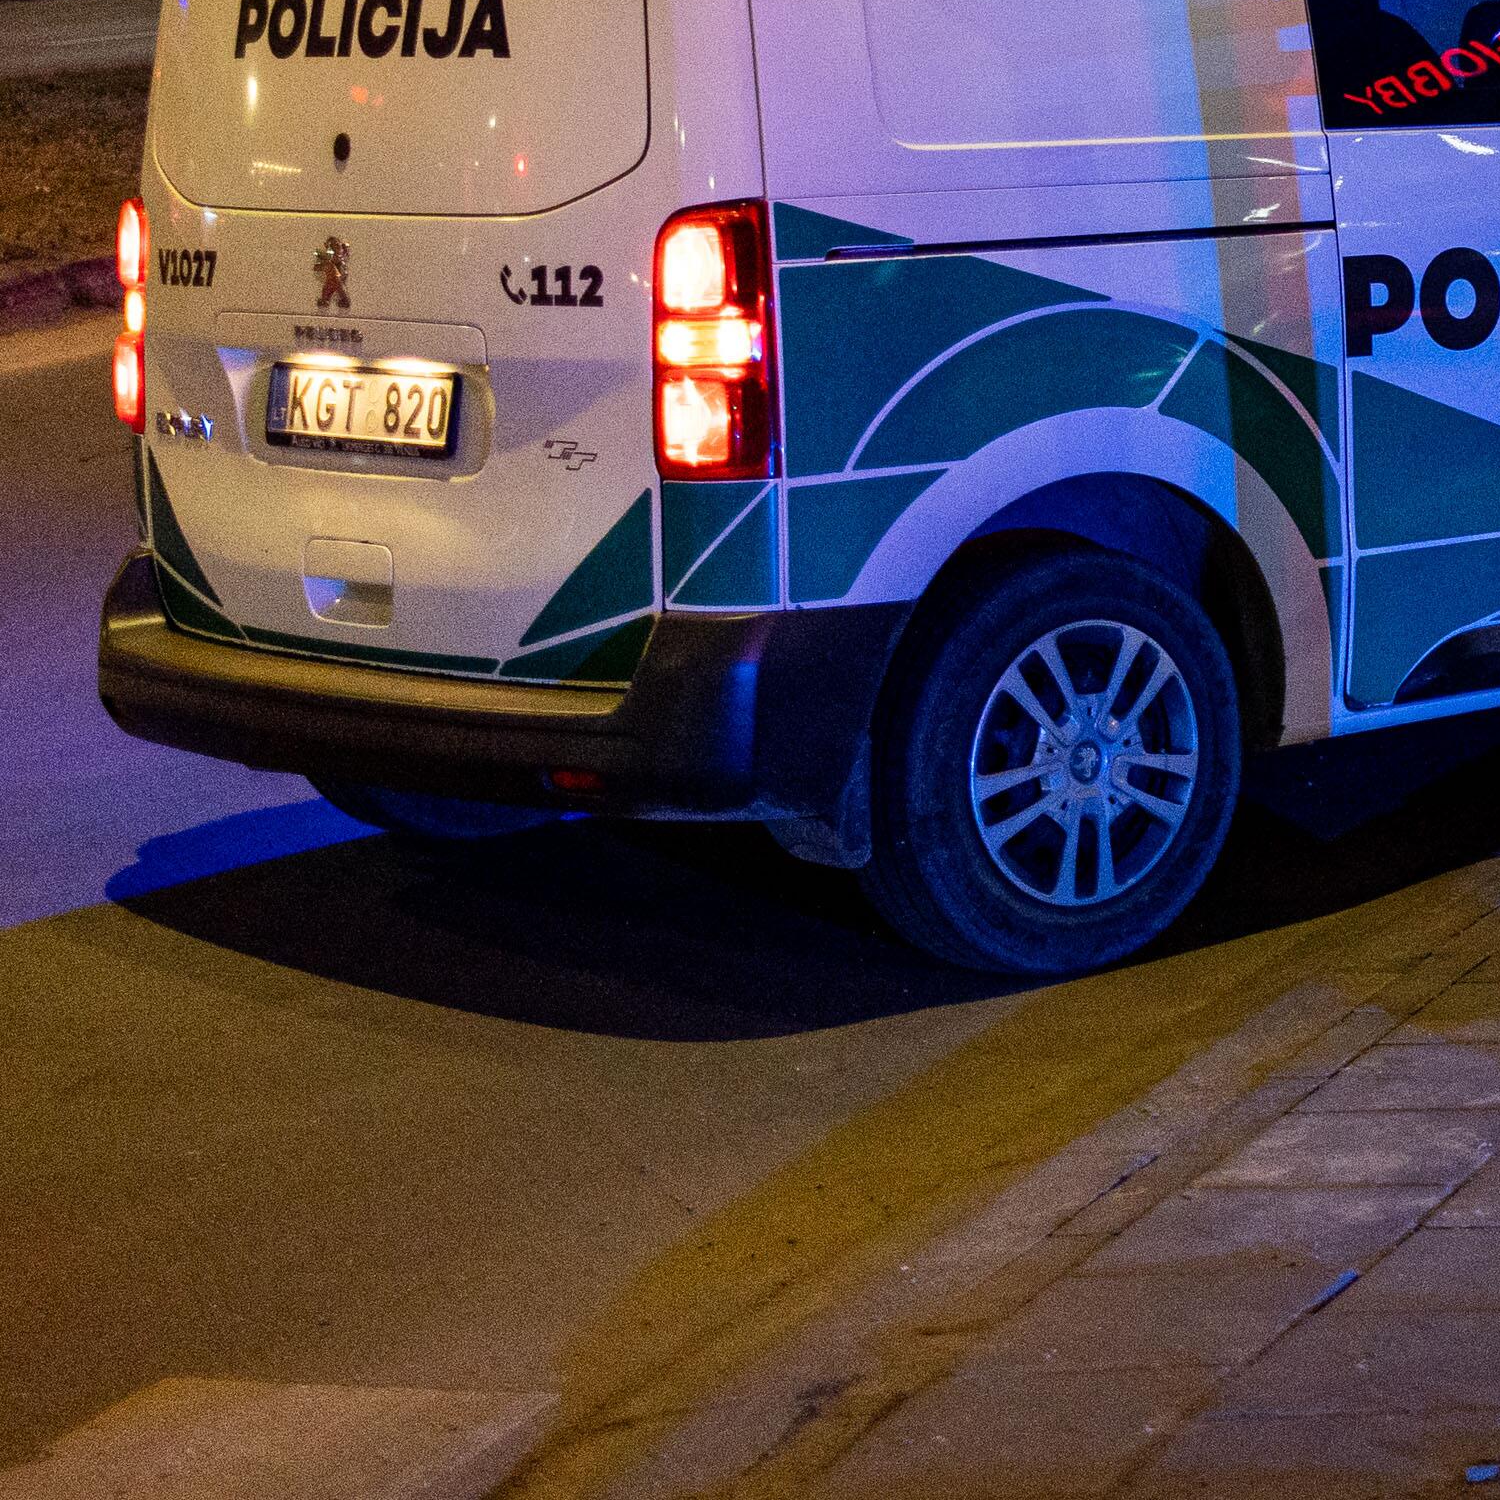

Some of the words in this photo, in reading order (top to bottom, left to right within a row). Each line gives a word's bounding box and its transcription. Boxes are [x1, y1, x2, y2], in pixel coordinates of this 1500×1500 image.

[158, 248, 217, 287] V1027
[530, 265, 604, 307] 112
[289, 375, 365, 432] KGT
[383, 381, 448, 440] 820
